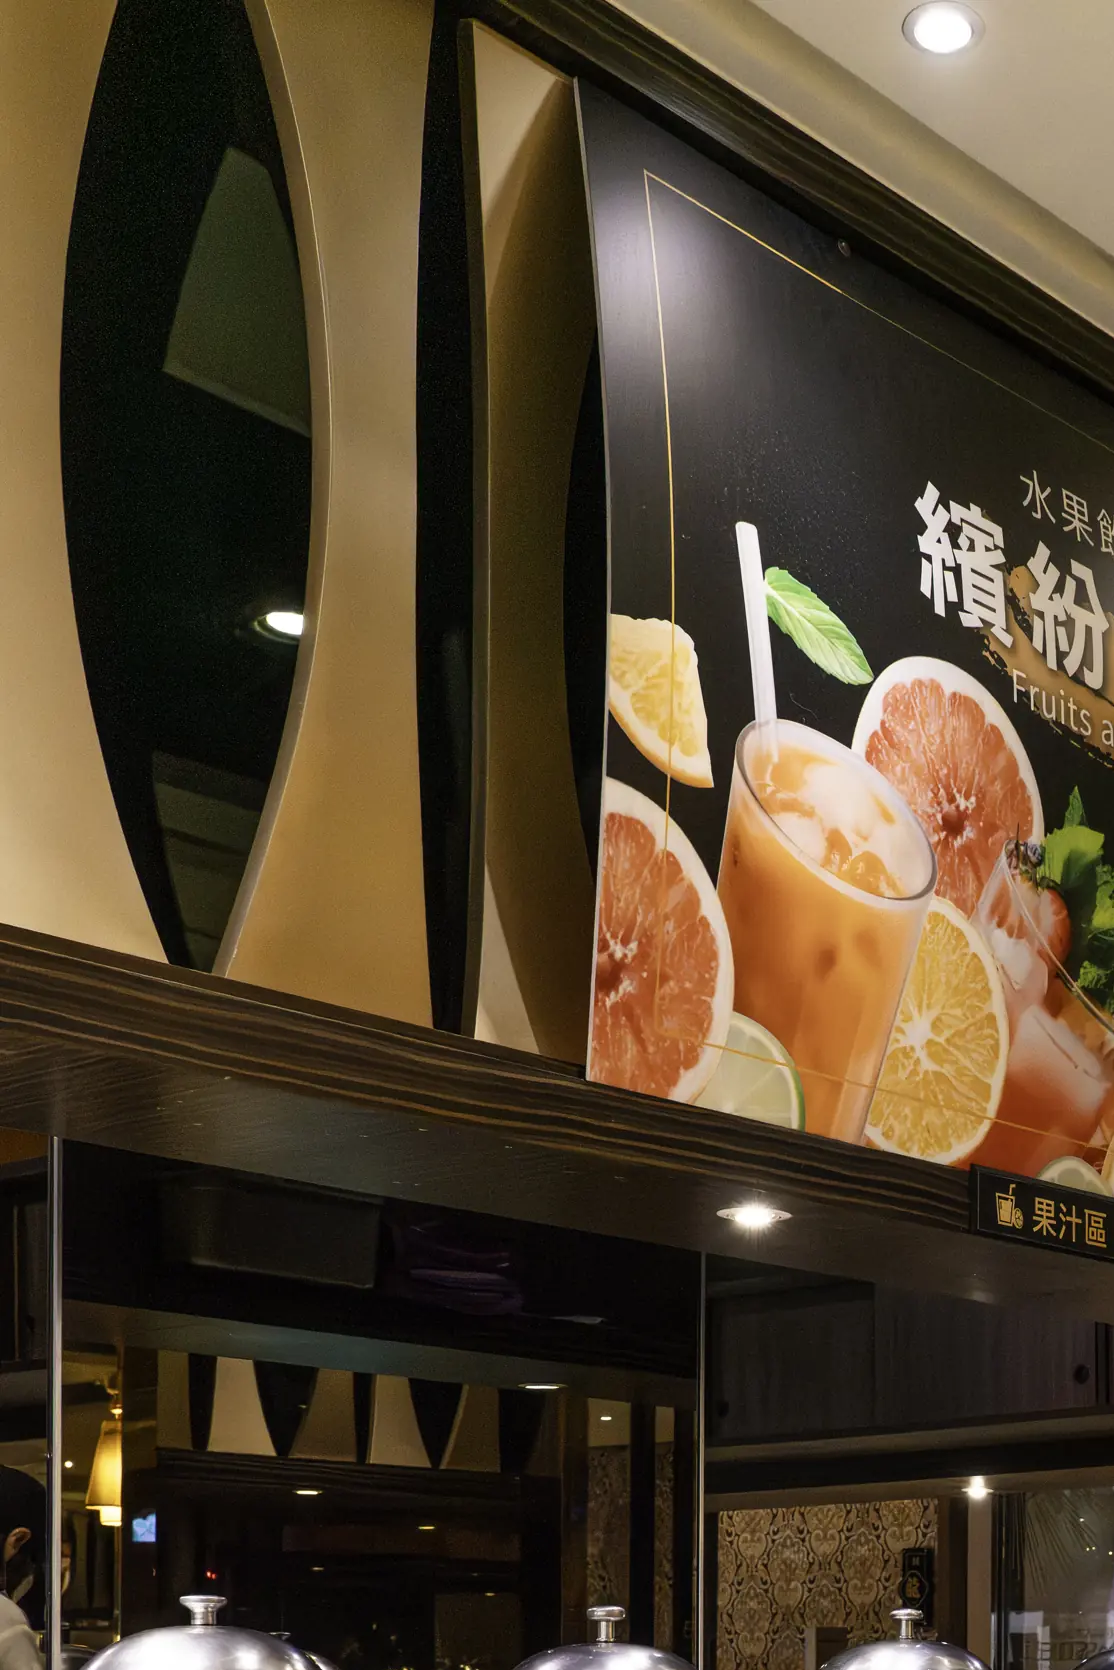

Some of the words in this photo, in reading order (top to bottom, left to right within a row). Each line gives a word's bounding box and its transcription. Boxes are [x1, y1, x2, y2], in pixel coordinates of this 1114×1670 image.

[1012, 668, 1092, 737] Fruits
[1032, 1197, 1108, 1249] 果汁區
